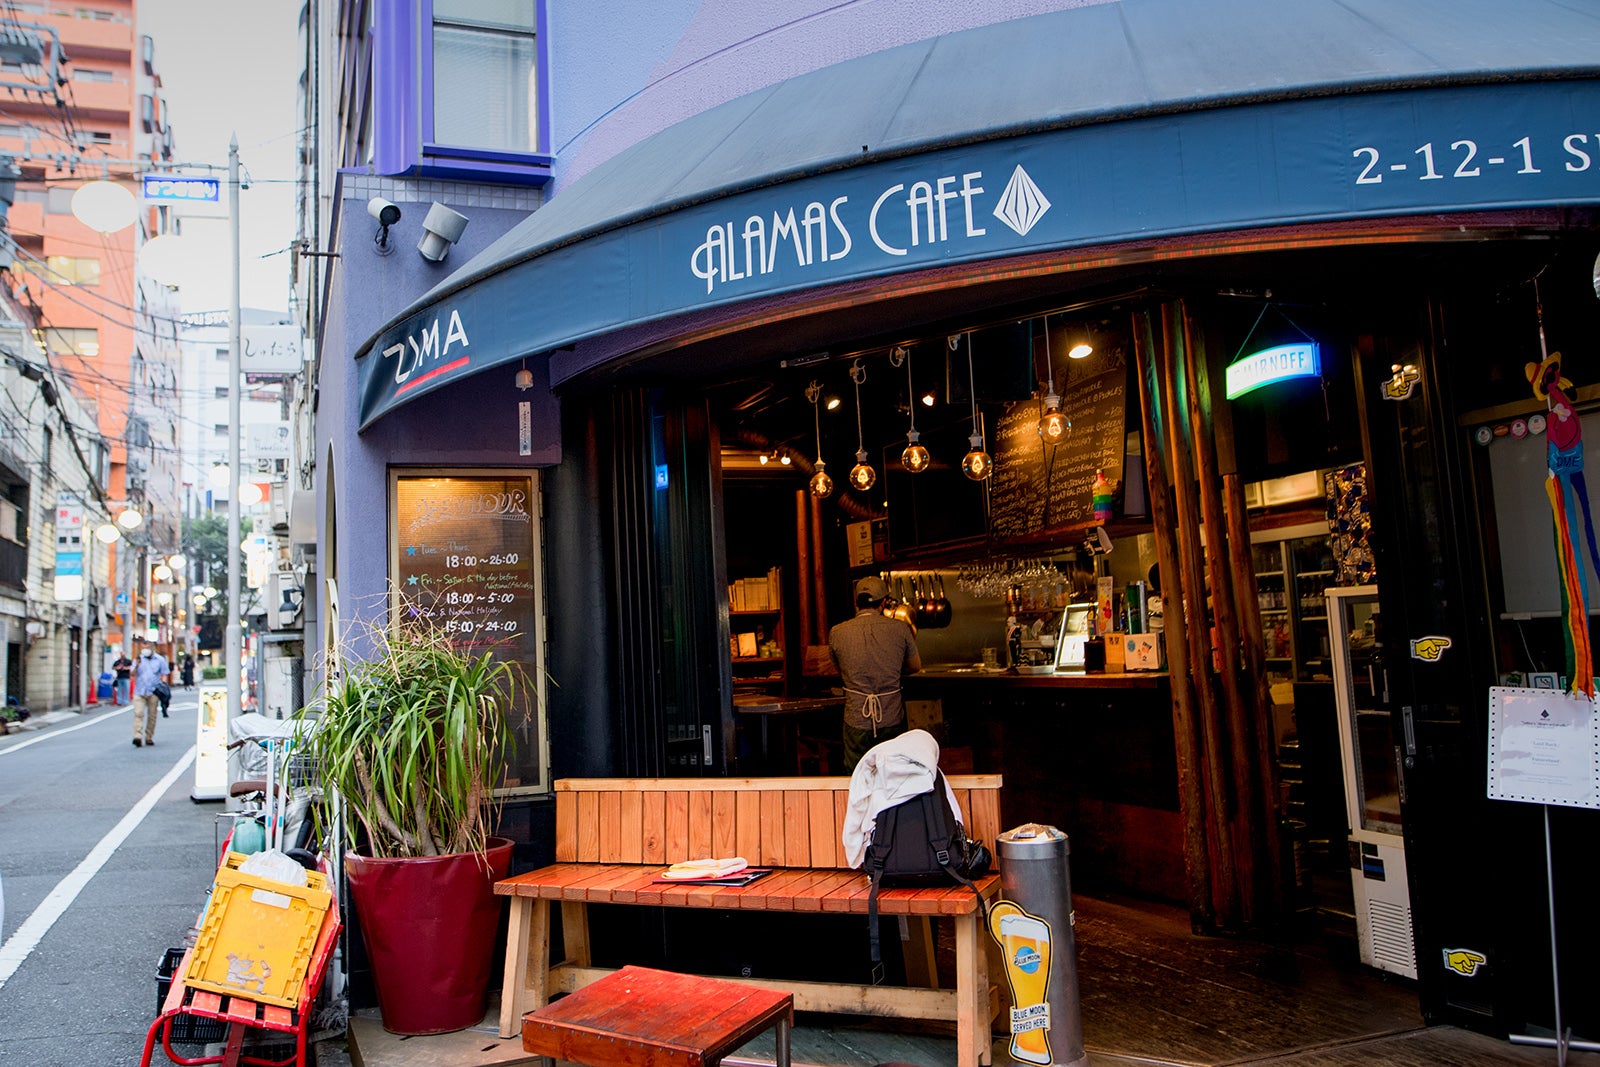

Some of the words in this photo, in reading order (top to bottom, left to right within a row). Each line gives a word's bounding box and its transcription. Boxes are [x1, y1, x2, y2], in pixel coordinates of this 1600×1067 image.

[1353, 136, 1541, 185] 2-12-1
[1563, 133, 1600, 172] S
[690, 195, 852, 296] ALAMAS
[868, 170, 987, 256] CAFE
[1014, 956, 1027, 966] BLUE
[1027, 953, 1041, 962] MOON
[1013, 1009, 1028, 1020] BLUE
[1029, 1005, 1046, 1016] MOON
[1013, 1021, 1032, 1032] SERVED
[1033, 1018, 1046, 1028] HERE
